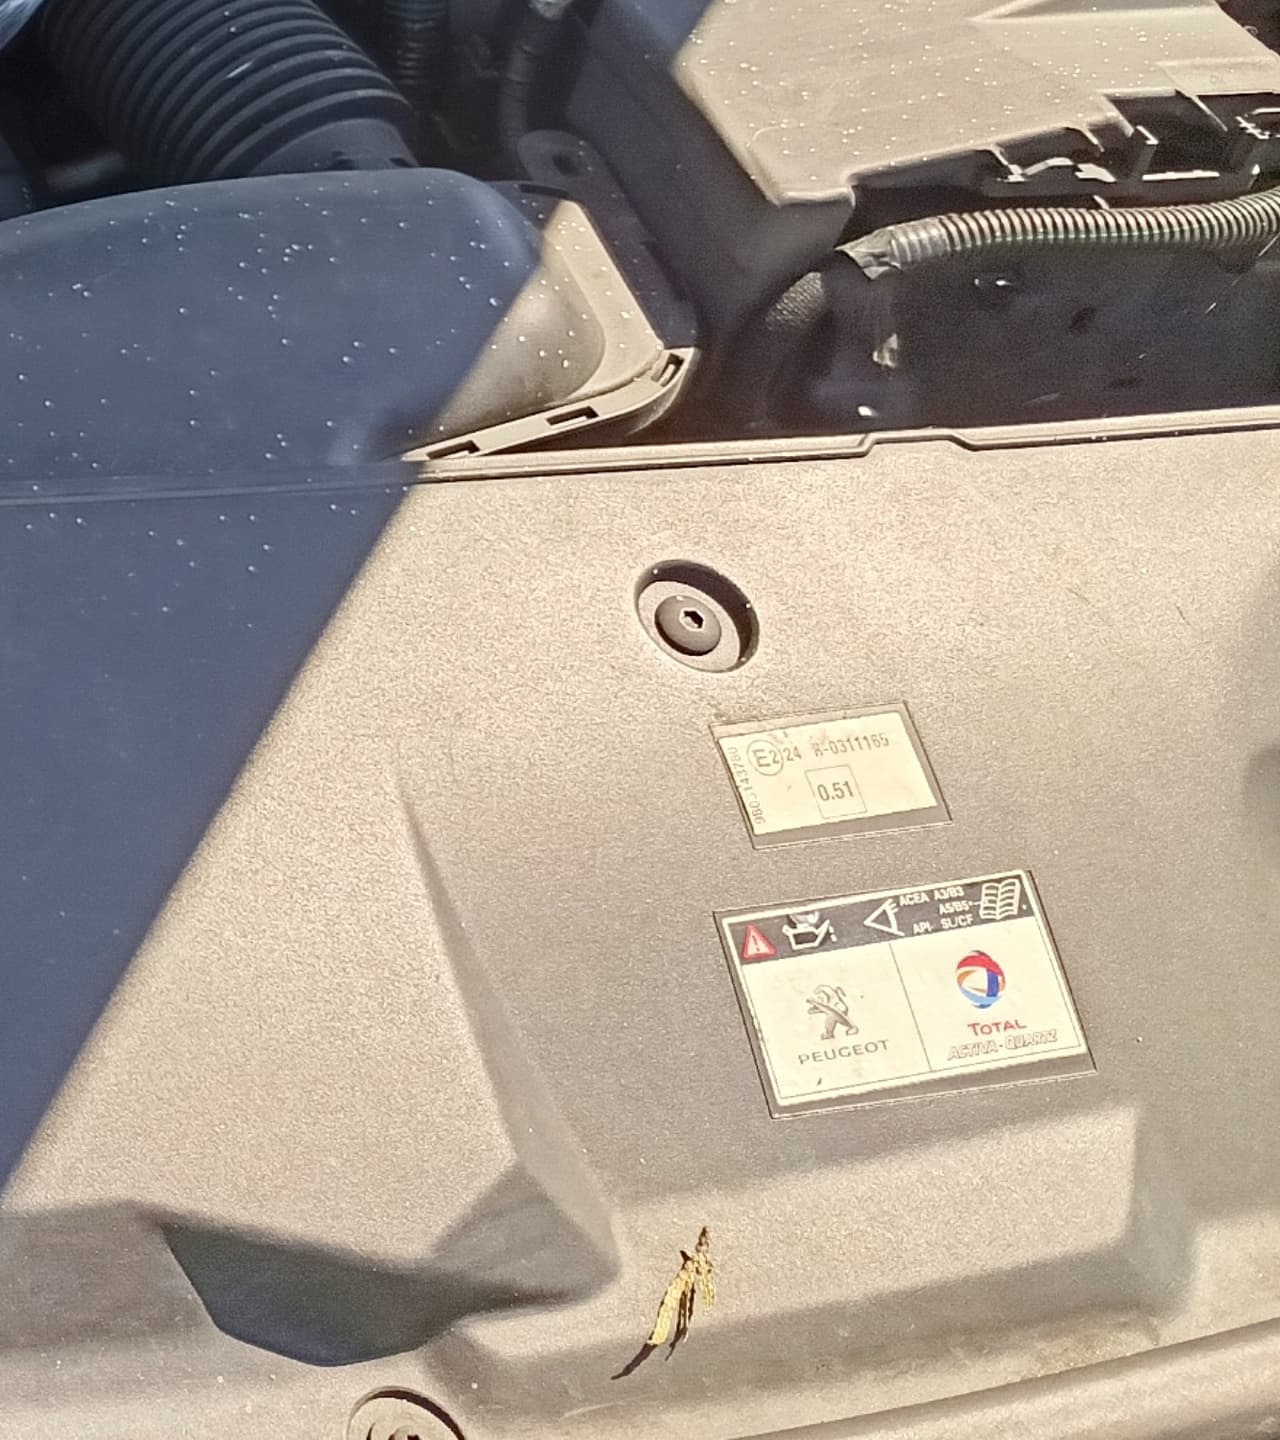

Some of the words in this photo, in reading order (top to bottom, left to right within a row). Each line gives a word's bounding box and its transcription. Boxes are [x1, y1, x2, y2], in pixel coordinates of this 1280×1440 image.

[783, 746, 802, 762] 24
[816, 780, 854, 801] 0.51
[899, 892, 930, 907] ACEA
[967, 1018, 1028, 1037] TOTAL
[797, 1039, 890, 1065] PEUGEOT
